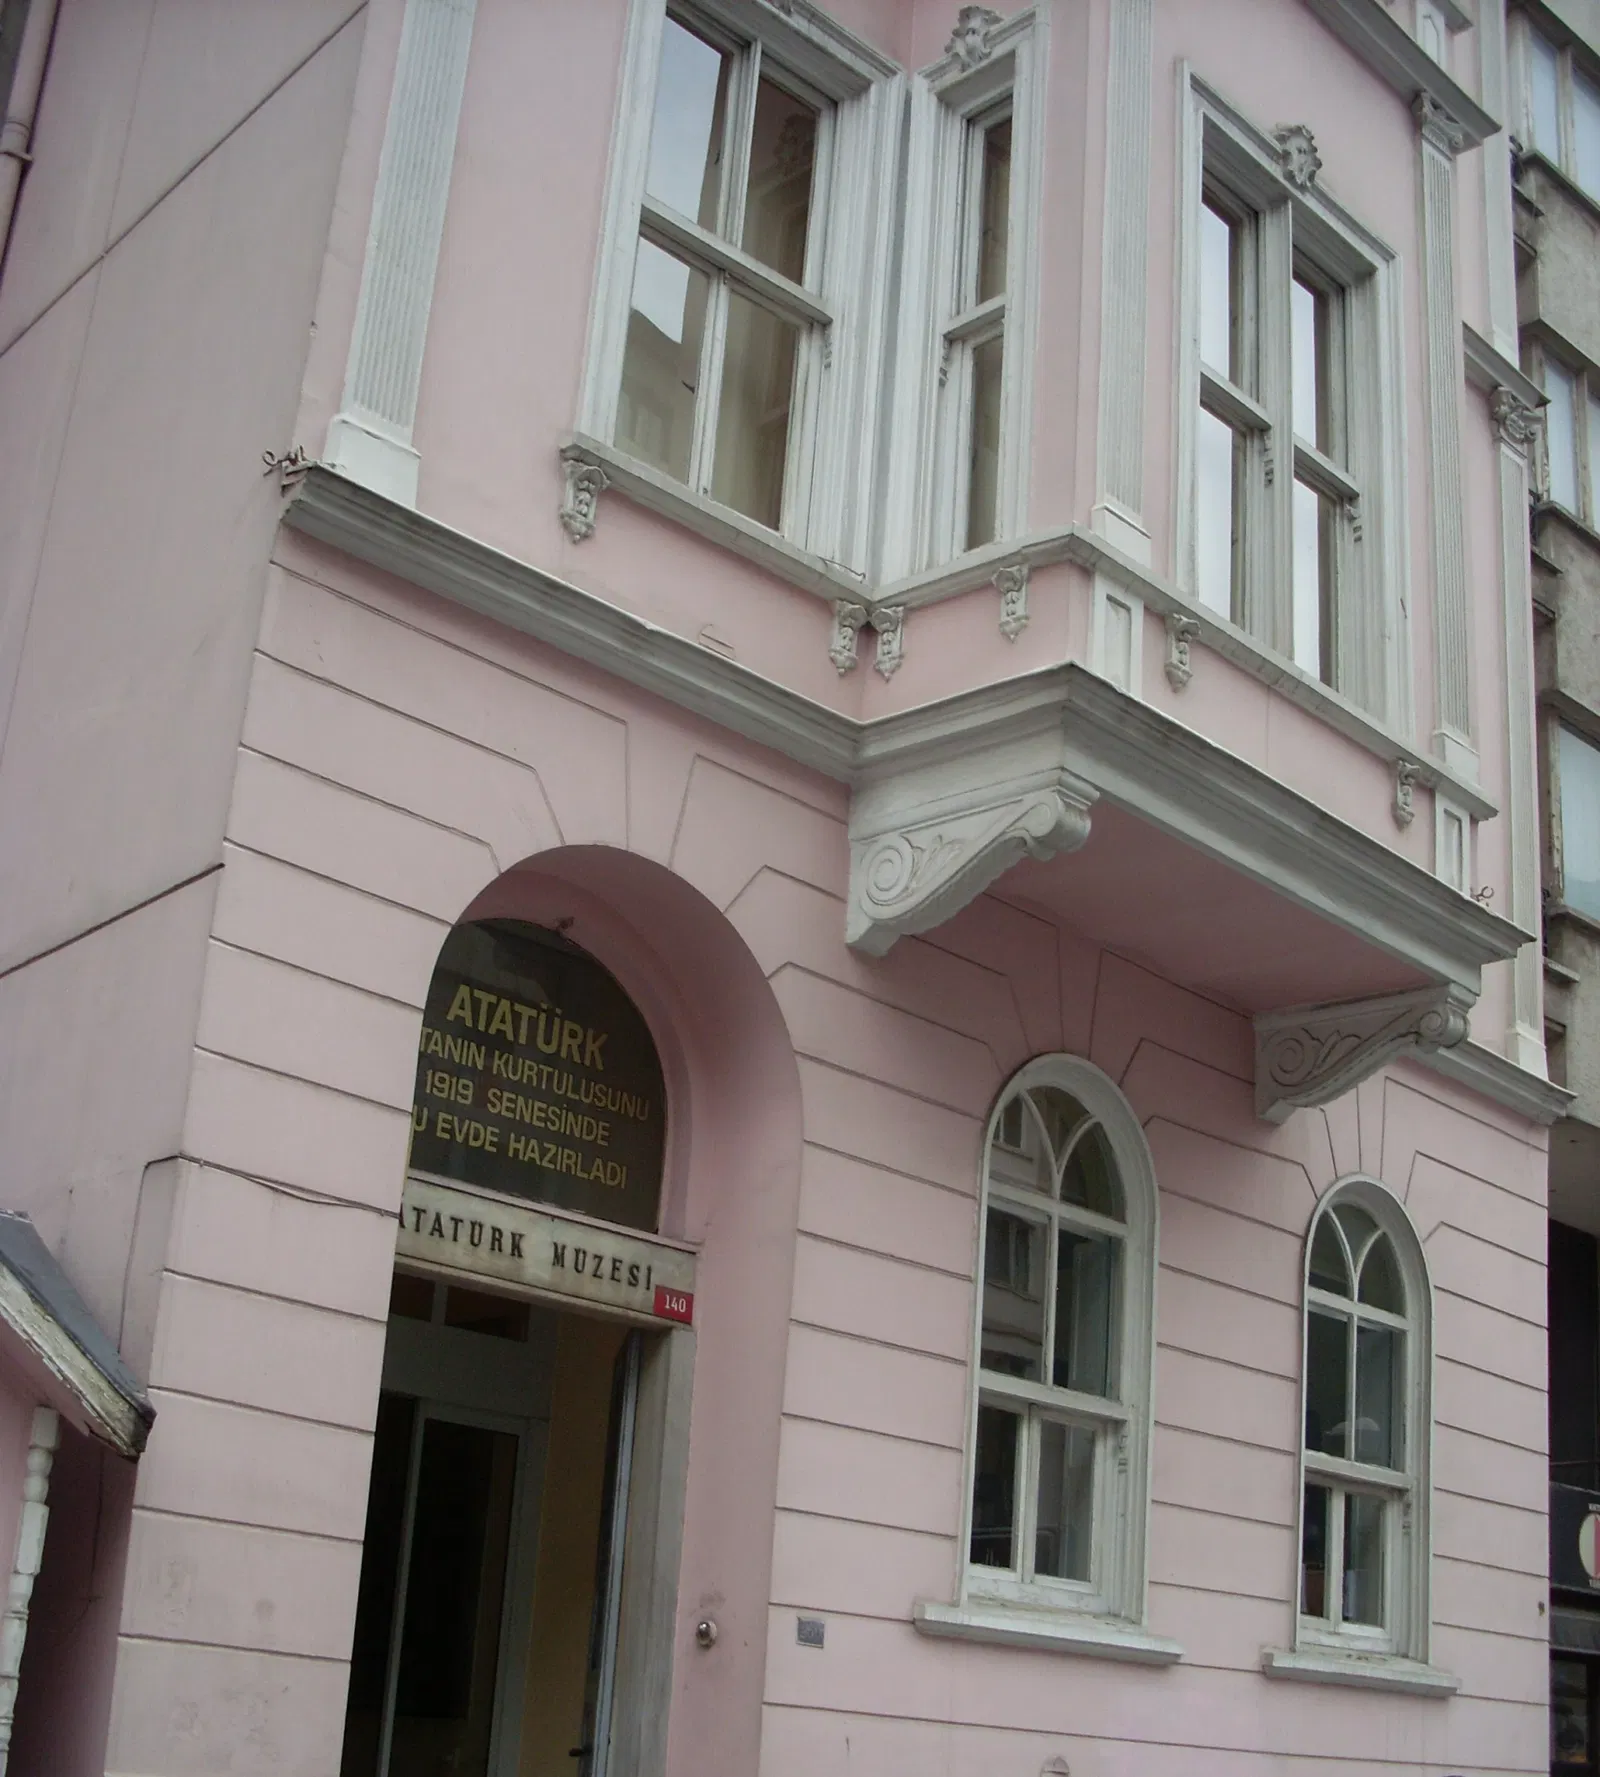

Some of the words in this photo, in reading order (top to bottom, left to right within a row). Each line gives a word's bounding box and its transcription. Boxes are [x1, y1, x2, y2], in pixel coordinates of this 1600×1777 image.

[446, 984, 609, 1071] ATATÜRK
[425, 1069, 474, 1105] 1919
[487, 1087, 611, 1148] SENESİNDE
[436, 1111, 500, 1153] EVDE
[508, 1132, 627, 1189] HAZIRLADI
[664, 1294, 687, 1313] 140
